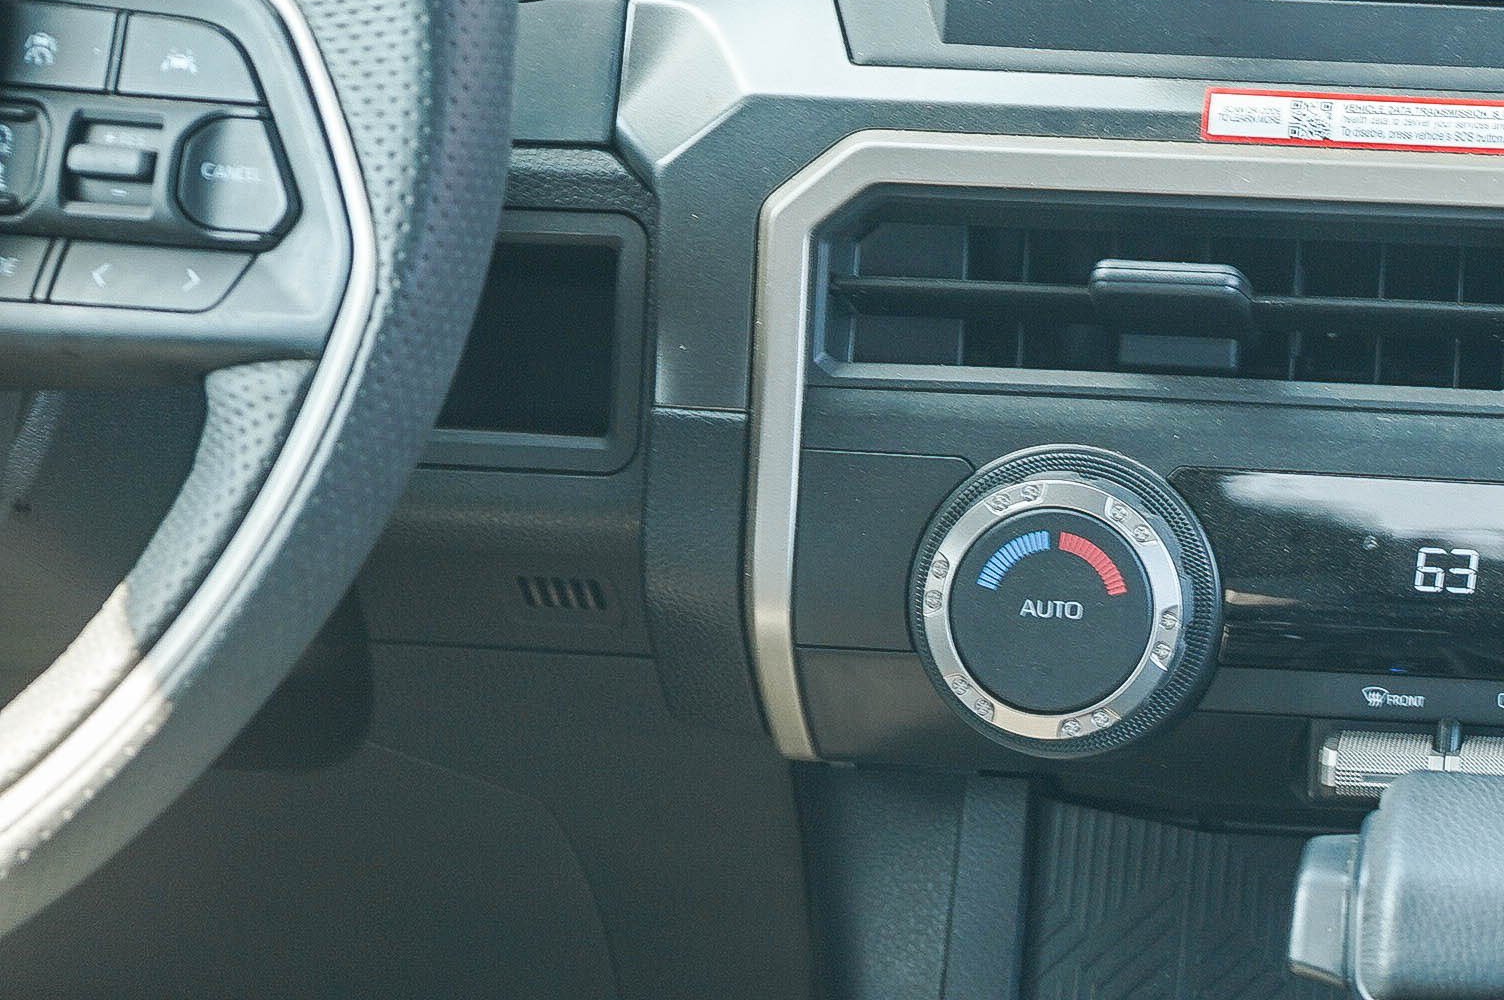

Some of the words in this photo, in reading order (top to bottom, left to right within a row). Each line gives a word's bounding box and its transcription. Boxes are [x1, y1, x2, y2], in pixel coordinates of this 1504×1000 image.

[1414, 547, 1479, 594] 63
[1020, 598, 1084, 620] AUTO
[1386, 693, 1426, 709] FRONT
